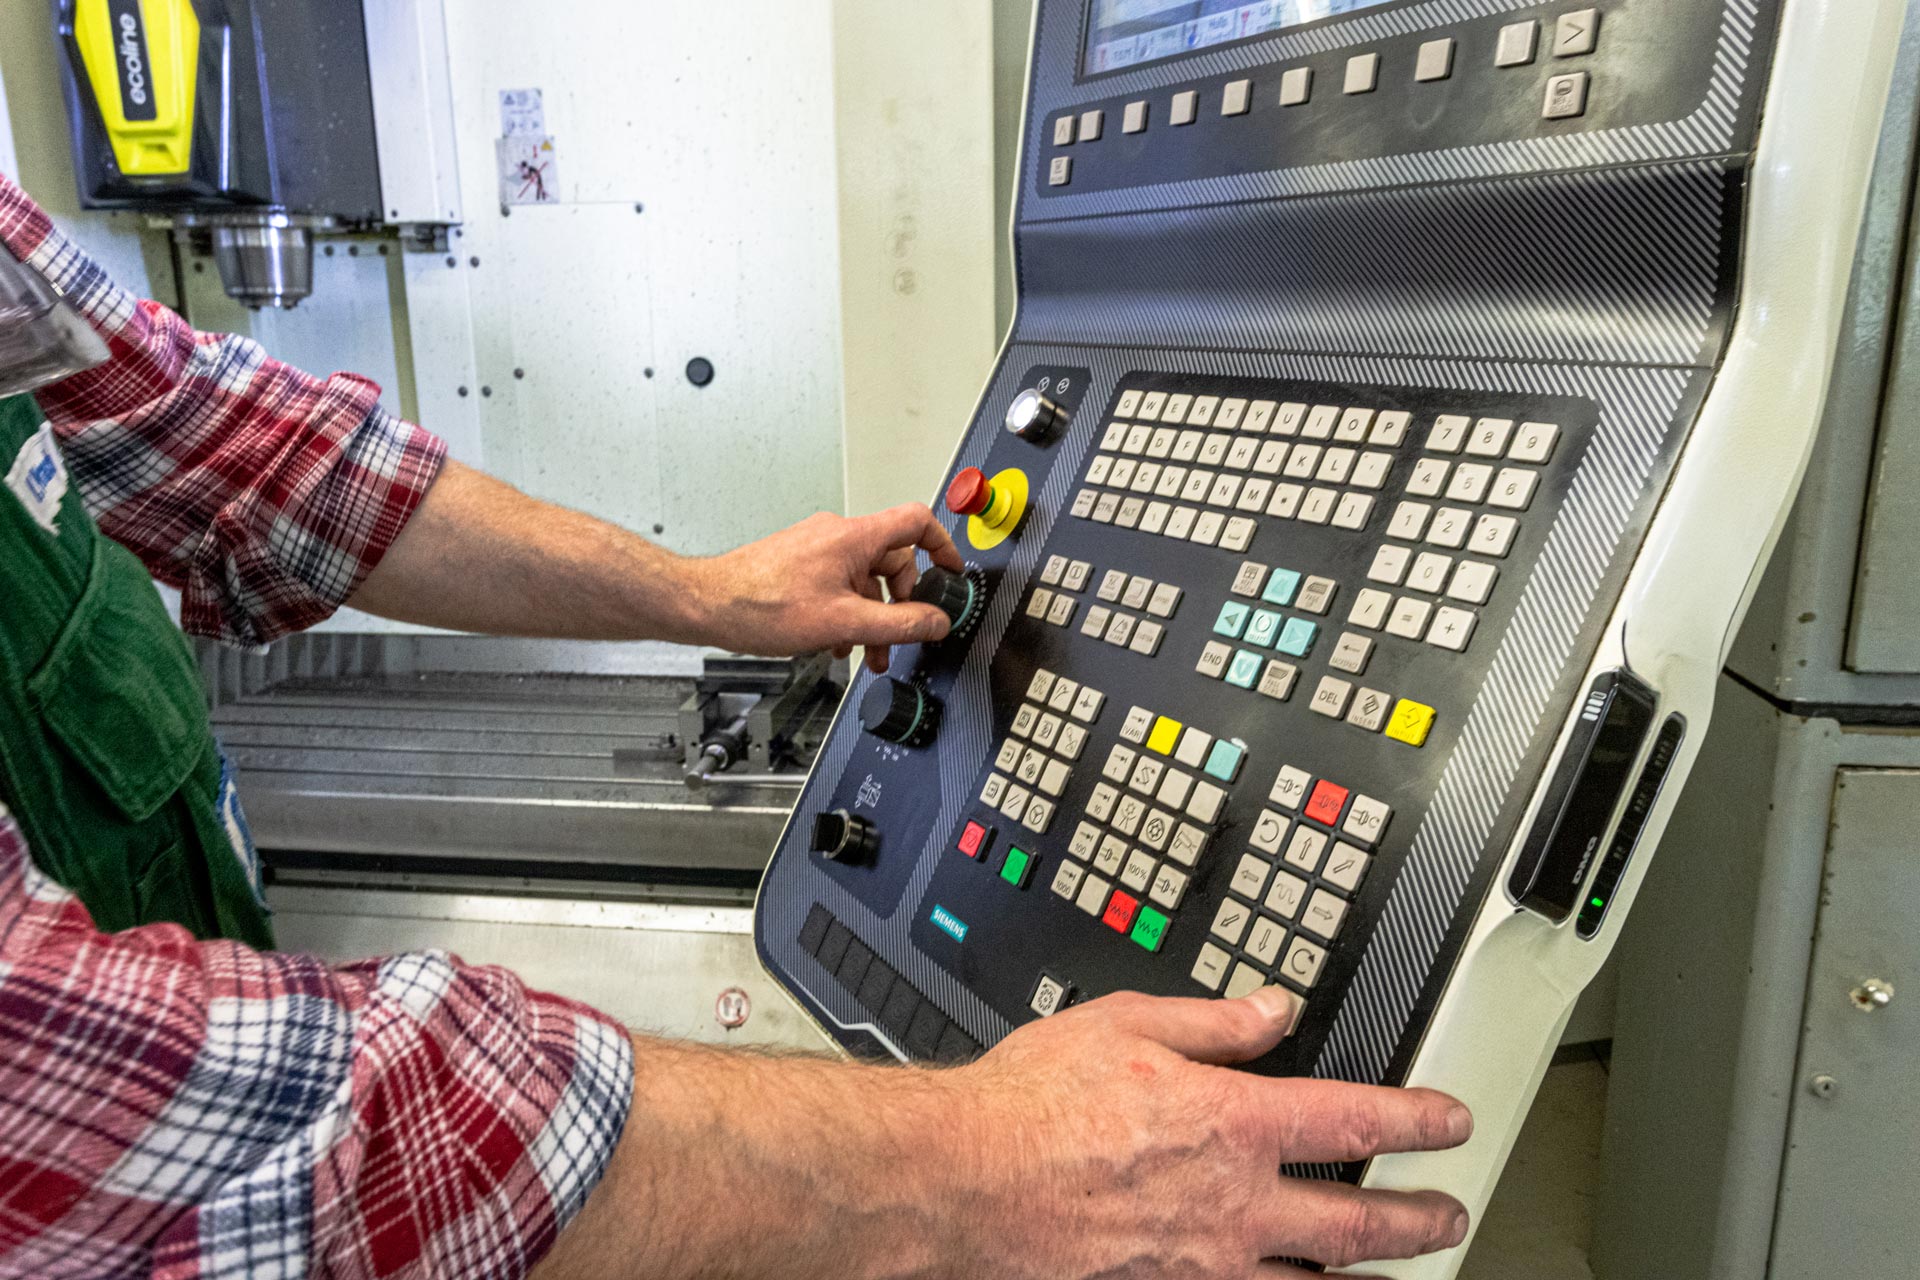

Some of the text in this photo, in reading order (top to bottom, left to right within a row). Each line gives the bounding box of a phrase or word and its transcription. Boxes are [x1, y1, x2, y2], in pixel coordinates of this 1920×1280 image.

[119, 13, 146, 105] ecoline
[1145, 400, 1155, 410] W
[1170, 403, 1178, 414] E
[1198, 405, 1207, 416] R
[1226, 408, 1235, 419] T
[1255, 411, 1264, 421] Y
[1283, 413, 1293, 424] U
[1316, 416, 1323, 427] I
[1348, 418, 1359, 431] O
[1383, 421, 1394, 433] P
[1441, 428, 1538, 449] 7 8 9
[1108, 432, 1338, 472] A S D F G H J K L
[1093, 464, 1259, 501] Z X C V B N M
[1422, 472, 1517, 496] 4 5 6
[1404, 514, 1498, 541] 1 2 3
[1202, 652, 1223, 666] END
[1318, 690, 1338, 706] DEL
[1351, 714, 1377, 727] INSERT
[1075, 843, 1087, 856] 100
[1572, 836, 1598, 885] DMG
[1128, 863, 1148, 881] 100%
[1056, 880, 1072, 896] 1000
[934, 909, 965, 938] SIEMENS
